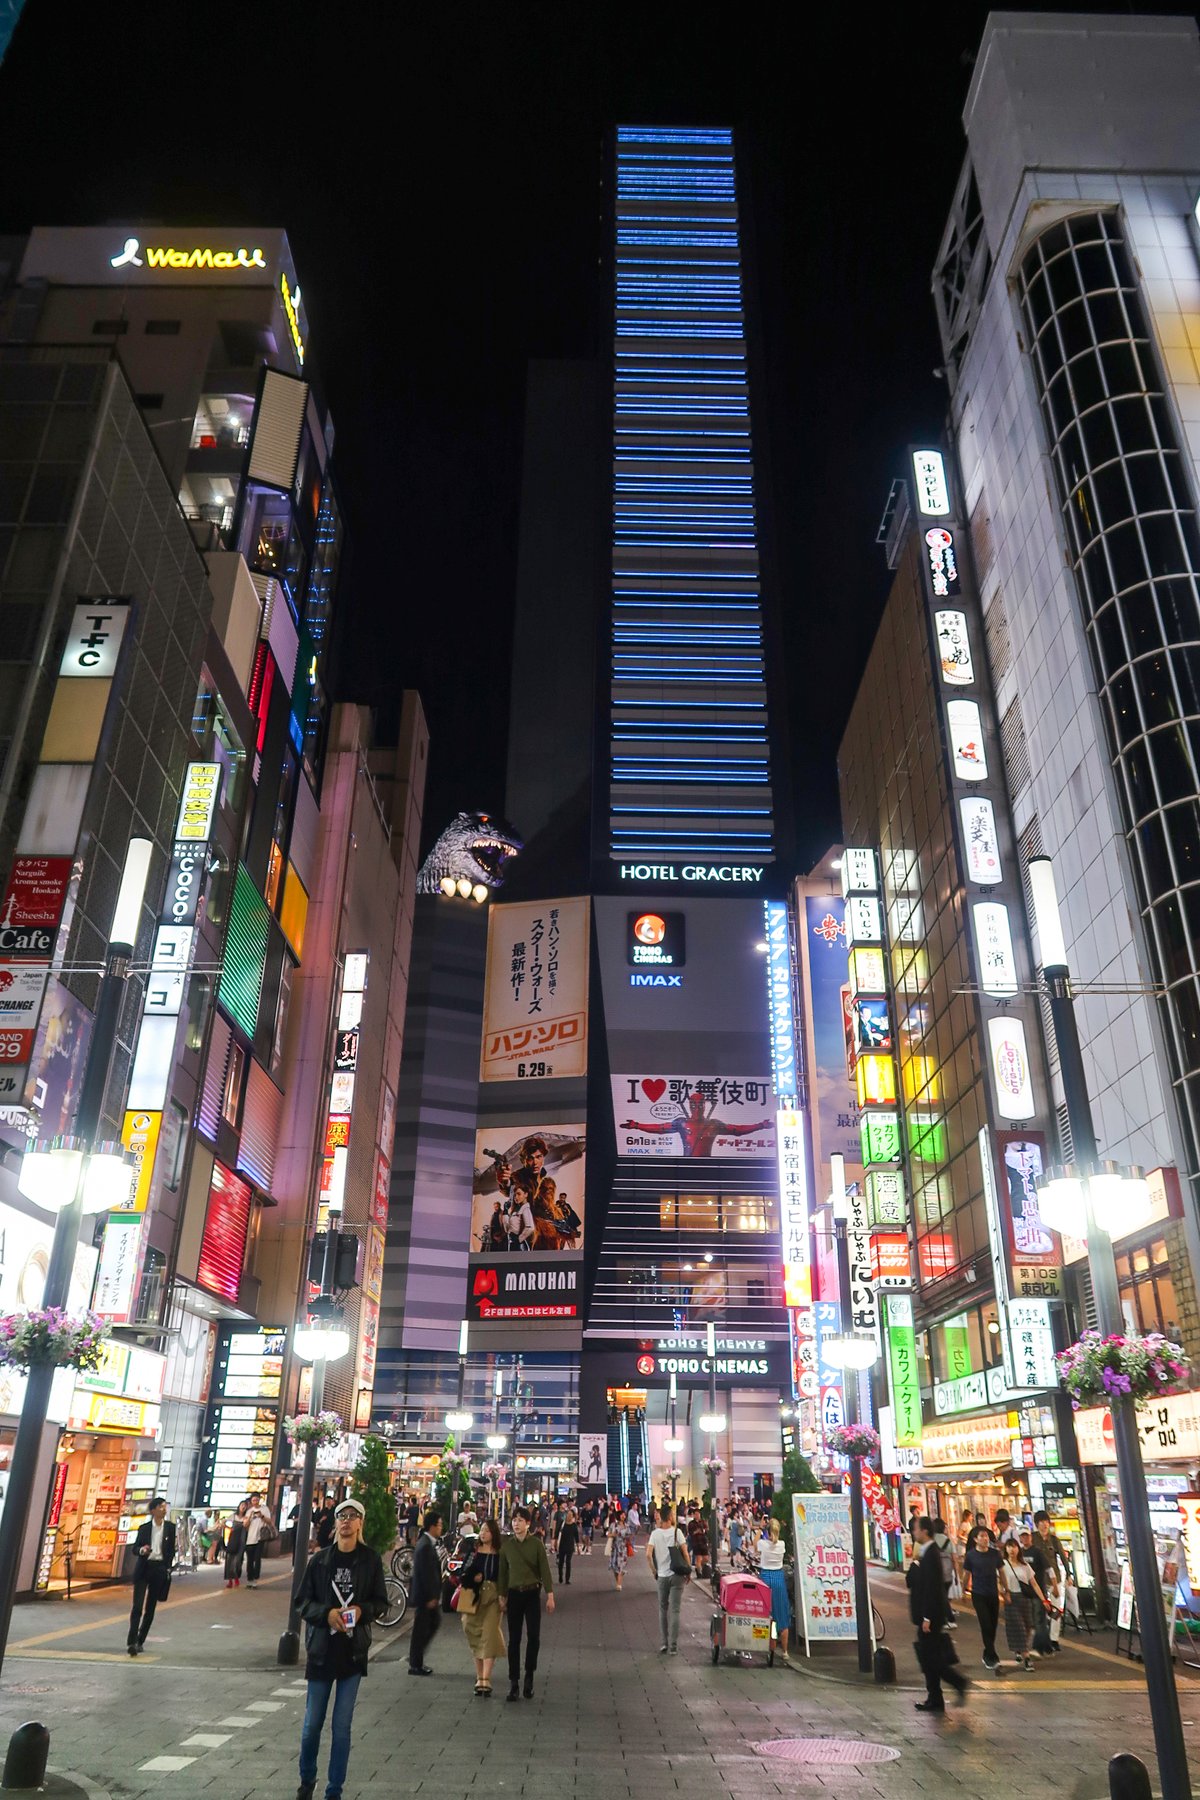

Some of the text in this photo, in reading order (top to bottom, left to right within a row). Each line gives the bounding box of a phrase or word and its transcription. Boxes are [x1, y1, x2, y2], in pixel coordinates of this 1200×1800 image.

[621, 865, 764, 882] HOTEL GRACERY
[32, 886, 61, 894] Hookah
[15, 911, 56, 920] Sheesha
[0, 930, 51, 950] Cafe
[633, 946, 663, 956] TOHO
[633, 955, 673, 965] CINEMAS
[630, 974, 682, 987] IMAX
[517, 1062, 546, 1078] 6.29
[628, 1079, 641, 1103] I
[505, 1271, 577, 1291] MARUHAN
[851, 1264, 876, 1329] にいむ
[1021, 1282, 1060, 1297] 東京ビル
[658, 1359, 700, 1374] TOHO
[816, 1545, 849, 1565] 1時間
[807, 1566, 857, 1578] ¥3,00
[823, 1590, 851, 1605] 予約
[811, 1606, 855, 1618] 承ります
